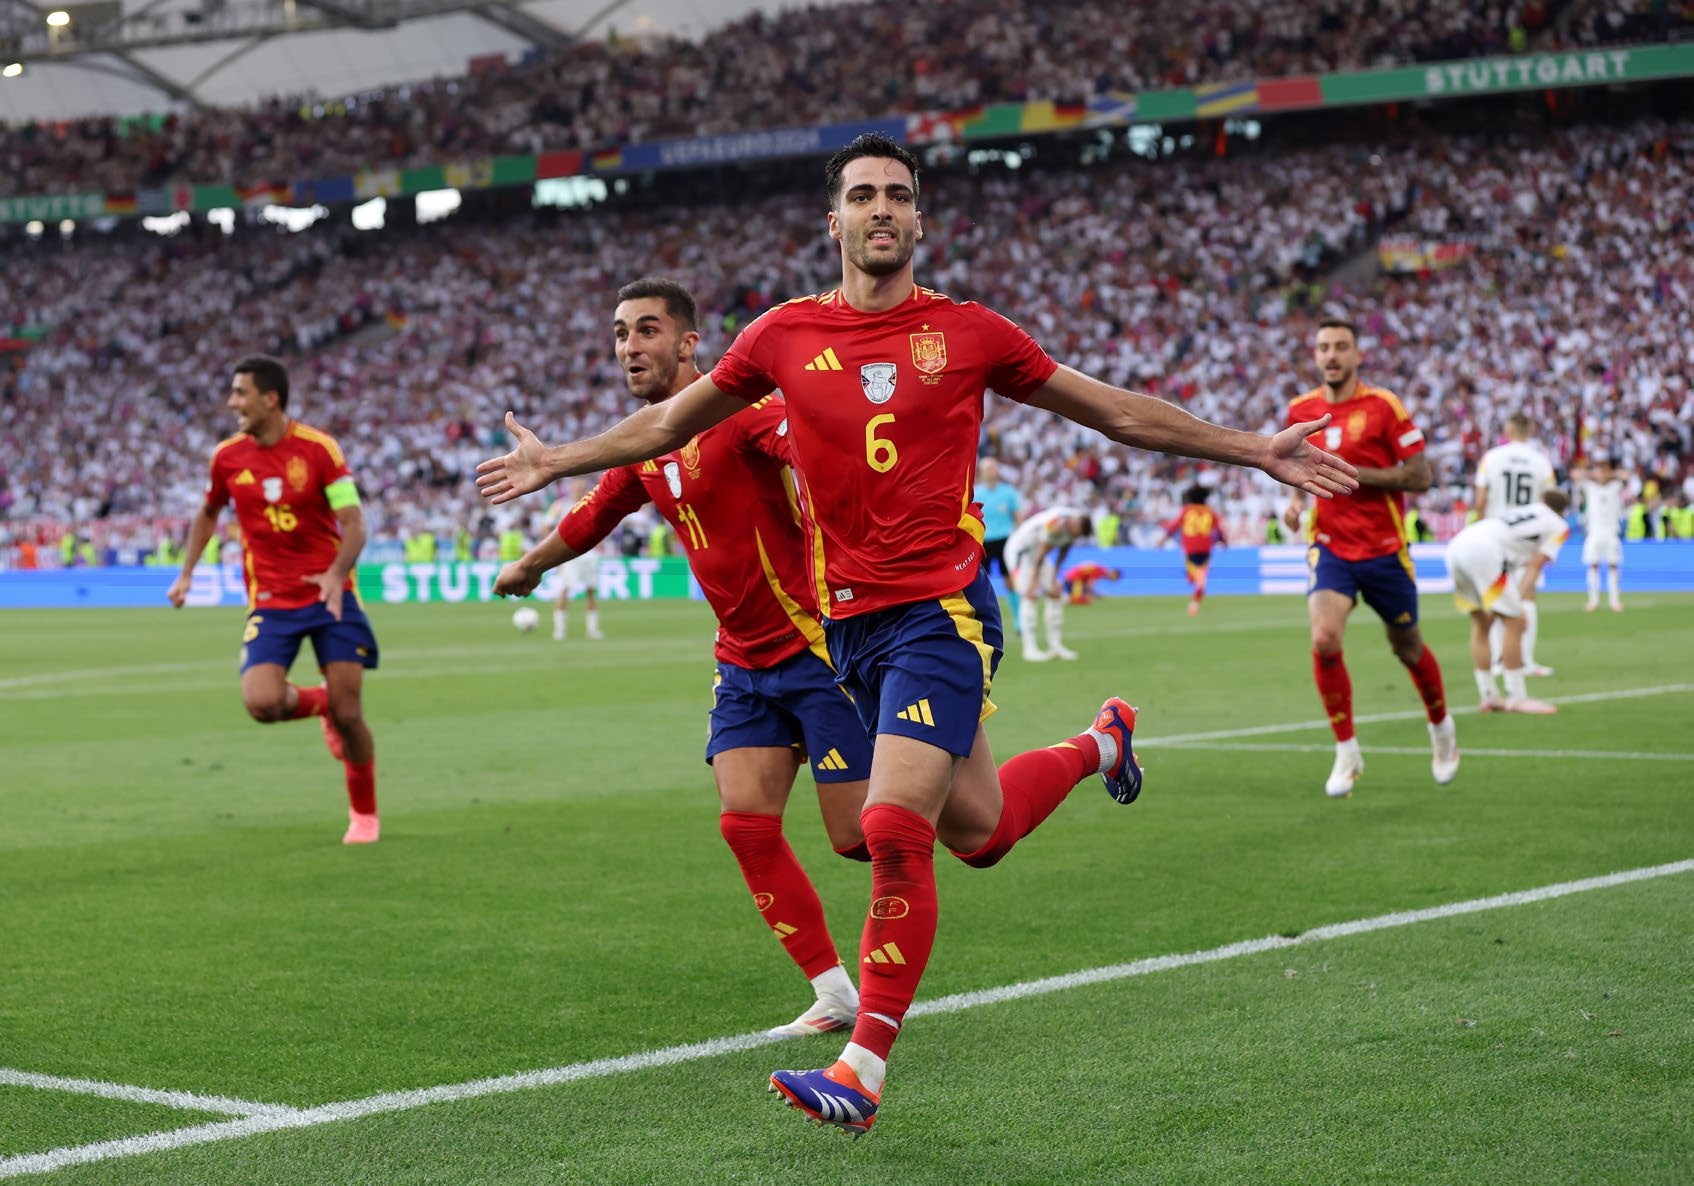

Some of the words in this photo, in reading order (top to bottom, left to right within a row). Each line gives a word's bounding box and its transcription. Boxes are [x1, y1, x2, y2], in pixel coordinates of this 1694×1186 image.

[1425, 51, 1630, 94] STUTTGART
[865, 413, 898, 473] 6
[1502, 471, 1533, 505] 16
[263, 504, 298, 533] 16
[676, 503, 709, 550] 11
